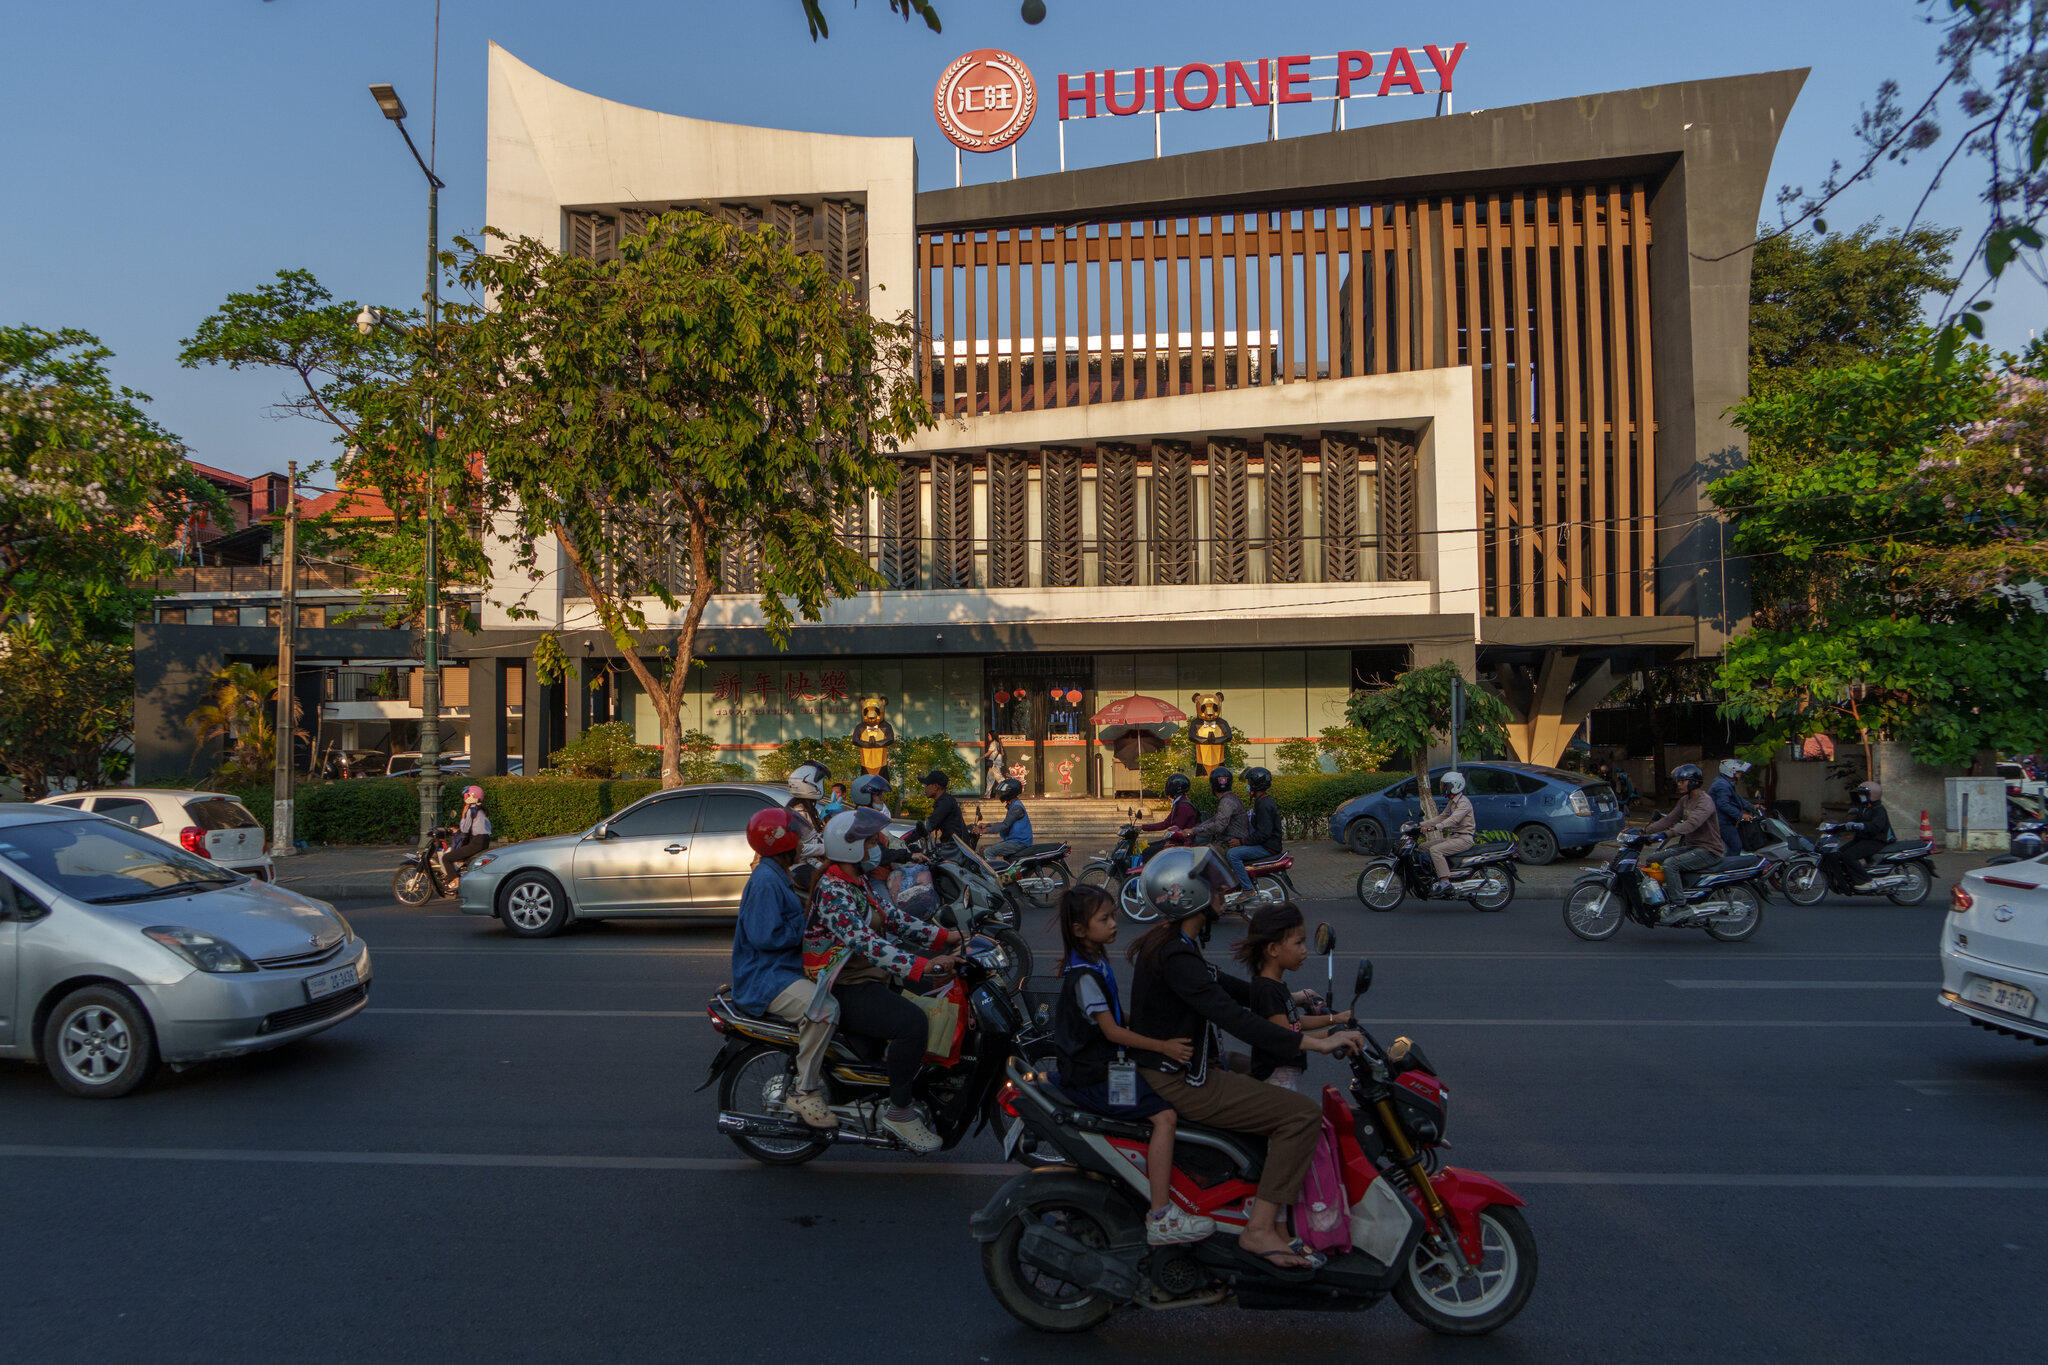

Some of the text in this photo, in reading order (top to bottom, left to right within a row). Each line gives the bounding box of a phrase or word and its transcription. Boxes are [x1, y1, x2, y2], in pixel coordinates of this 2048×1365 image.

[1058, 42, 1468, 121] HUIONE PAY
[713, 670, 849, 705] 新年快樂
